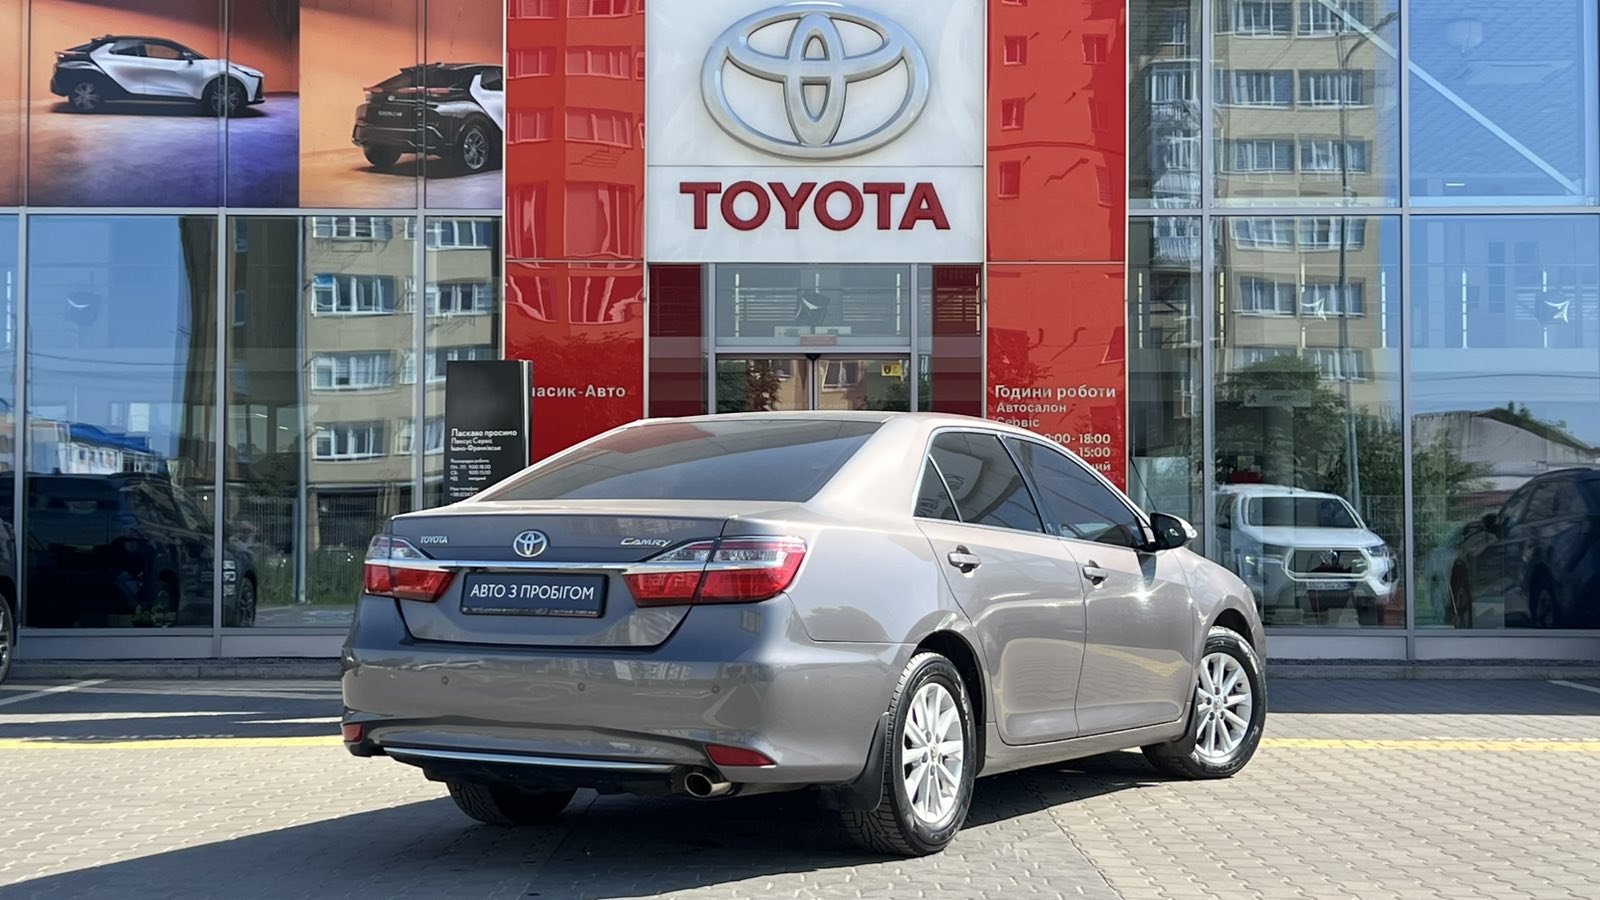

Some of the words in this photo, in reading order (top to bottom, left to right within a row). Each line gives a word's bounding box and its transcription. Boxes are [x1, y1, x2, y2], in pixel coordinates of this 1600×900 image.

[679, 180, 951, 231] TOYOTA
[995, 384, 1052, 400] Години
[1057, 384, 1116, 400] роботи
[996, 402, 1067, 413] Автосалон
[484, 430, 518, 438] просимо
[1078, 433, 1111, 444] 18:00
[420, 535, 449, 544] TOYOTA
[470, 583, 506, 598] АВТО
[520, 584, 595, 600] ПРОБІГОМ
